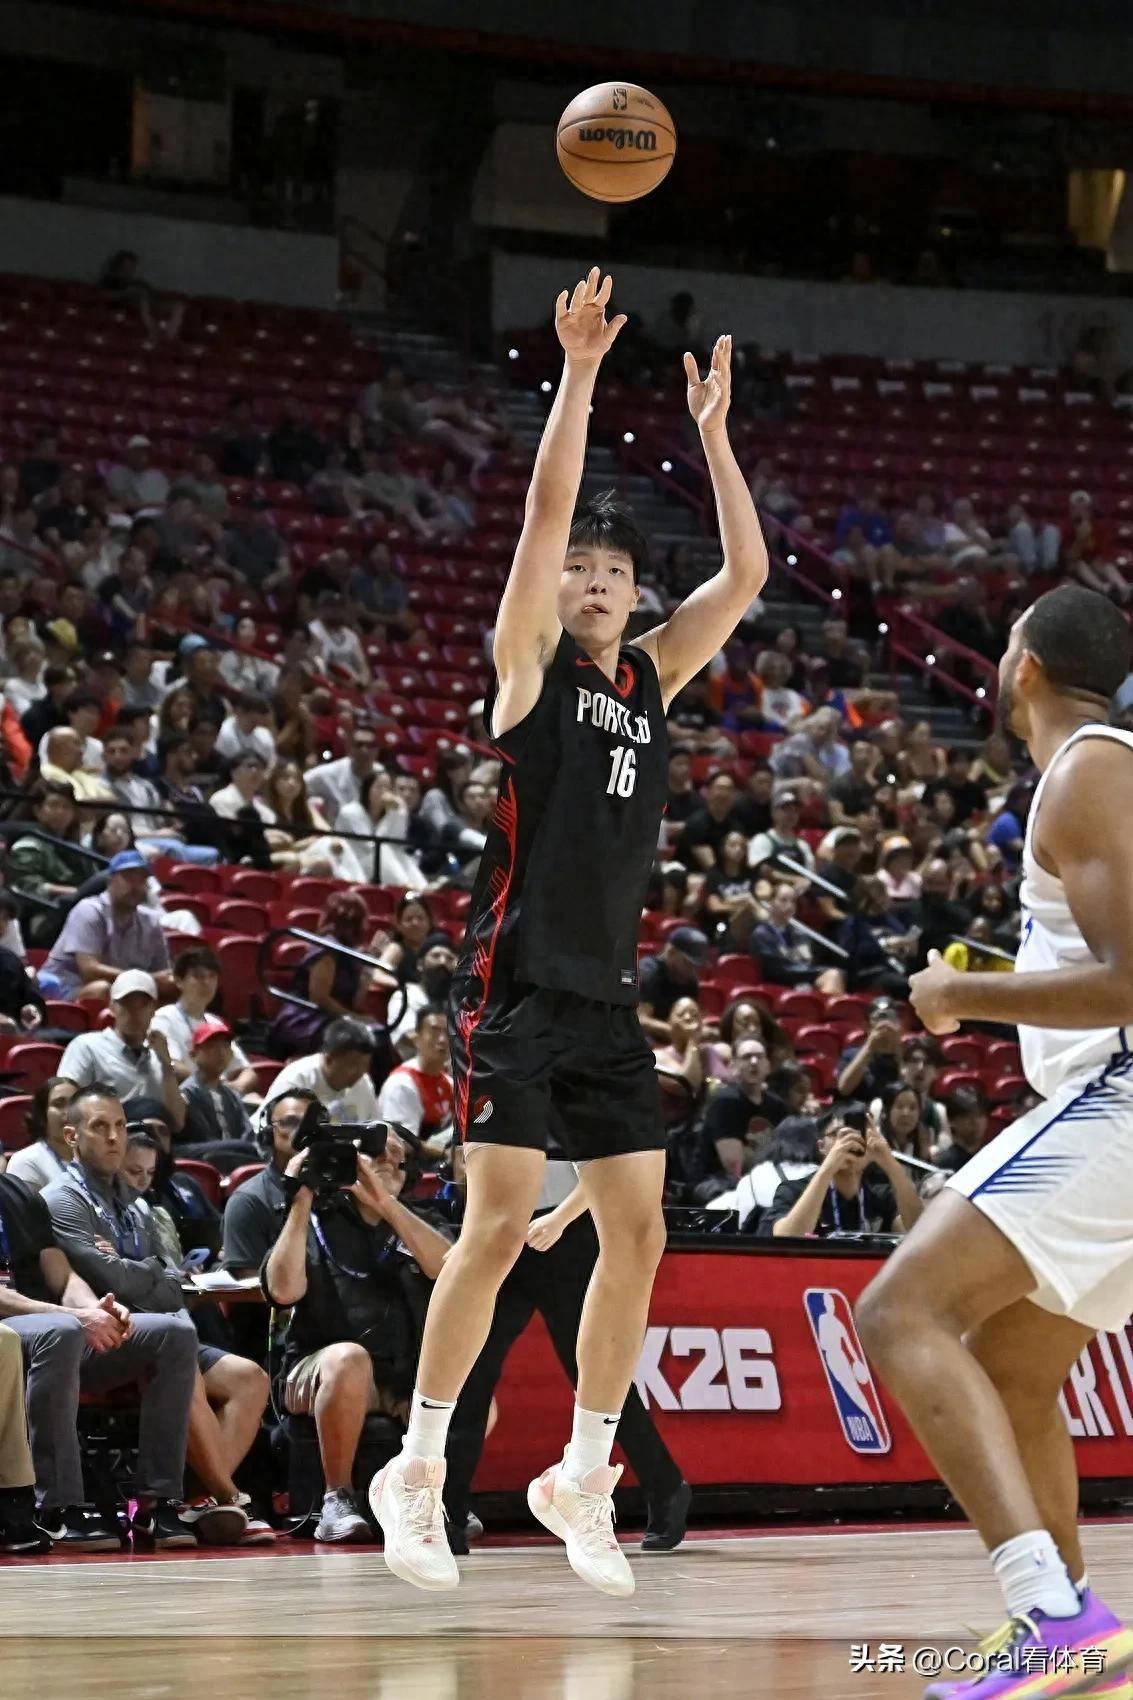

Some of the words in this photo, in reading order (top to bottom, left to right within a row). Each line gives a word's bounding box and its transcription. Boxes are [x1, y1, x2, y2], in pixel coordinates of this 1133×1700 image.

[578, 127, 657, 151] Wilson
[606, 745, 636, 798] 16
[633, 1327, 782, 1411] K26
[846, 1416, 874, 1441] NBA
